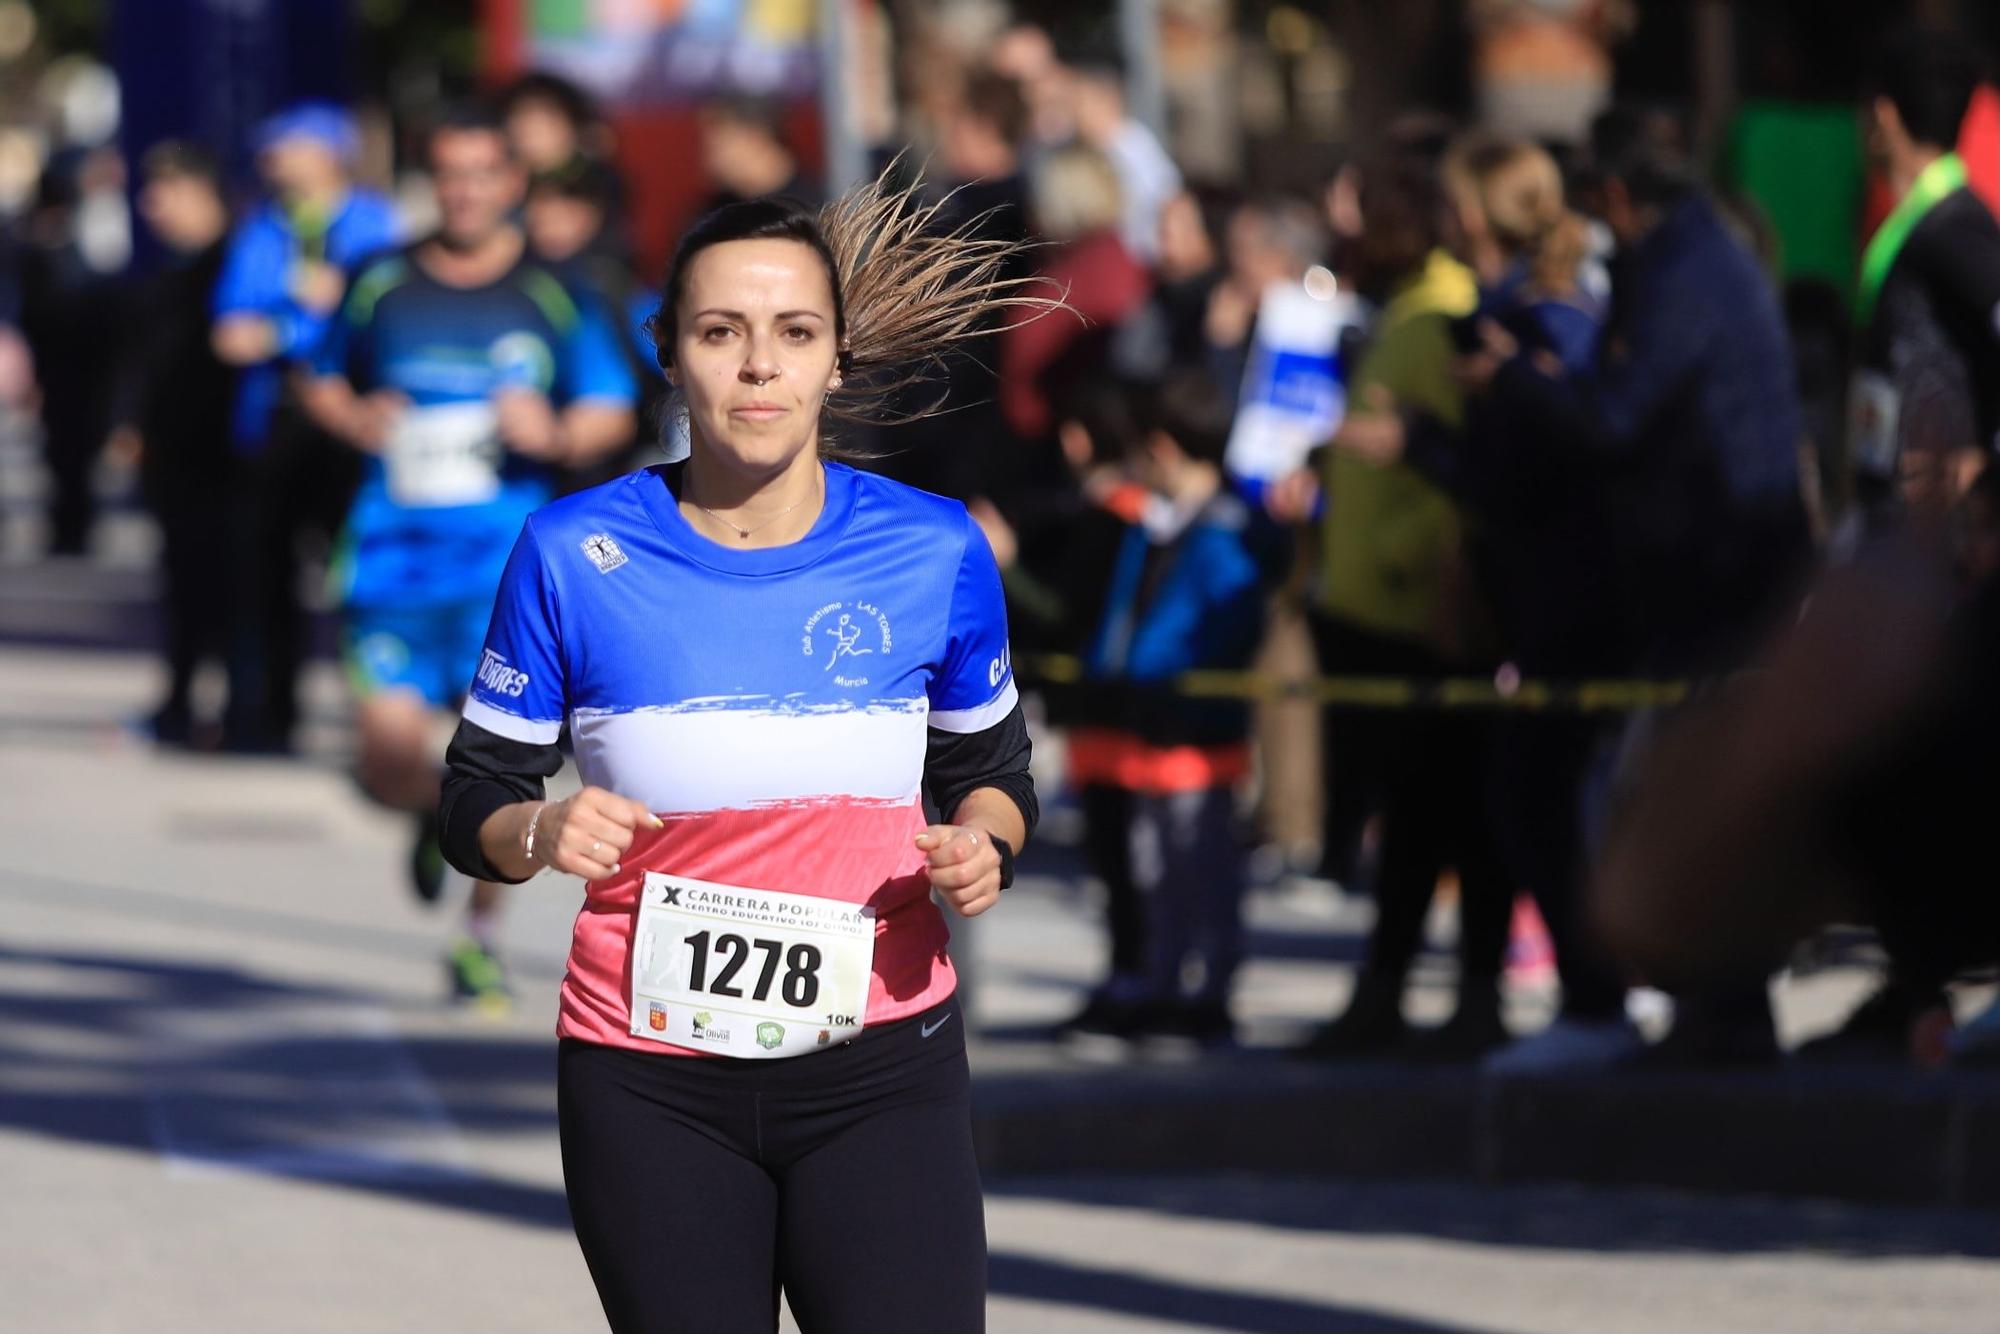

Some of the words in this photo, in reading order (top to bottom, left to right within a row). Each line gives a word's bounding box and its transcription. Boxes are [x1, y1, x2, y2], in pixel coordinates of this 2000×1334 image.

[805, 602, 842, 632] Atletismo
[857, 600, 878, 615] LAS
[878, 612, 892, 654] TORRES
[478, 648, 529, 697] TORRES
[834, 675, 869, 687] Murcia
[662, 885, 683, 907] X
[688, 889, 770, 912] CARRERA
[778, 902, 863, 924] POPULAR
[685, 903, 727, 915] CENTRO
[731, 910, 796, 925] EDUCATIVO
[684, 930, 822, 1007] 1278
[826, 1014, 856, 1026] 10K
